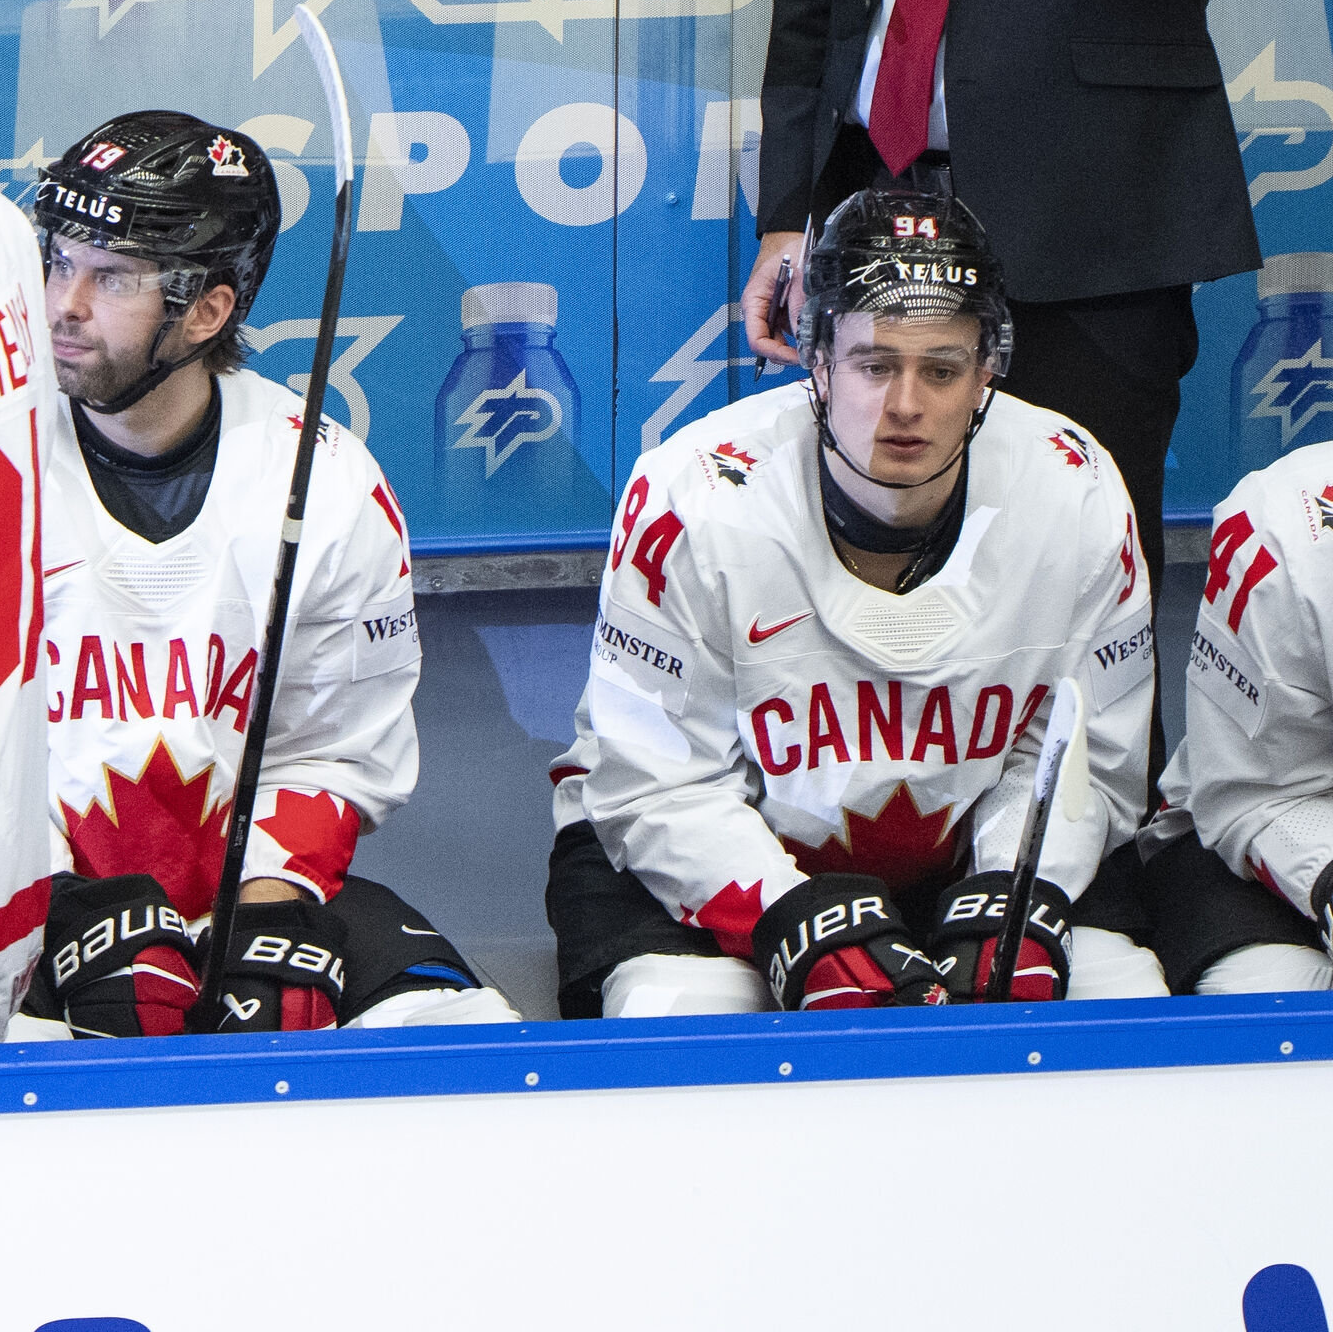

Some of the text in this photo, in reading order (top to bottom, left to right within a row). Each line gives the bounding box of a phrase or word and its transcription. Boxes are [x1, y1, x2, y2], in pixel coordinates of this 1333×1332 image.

[79, 141, 127, 171] 19
[56, 186, 123, 225] TELUS
[893, 215, 941, 241] 94
[895, 263, 978, 286] TELUS
[695, 447, 717, 491] CANADA
[1301, 489, 1320, 543] CANADA
[611, 474, 685, 609] 94
[1204, 509, 1279, 637] 41
